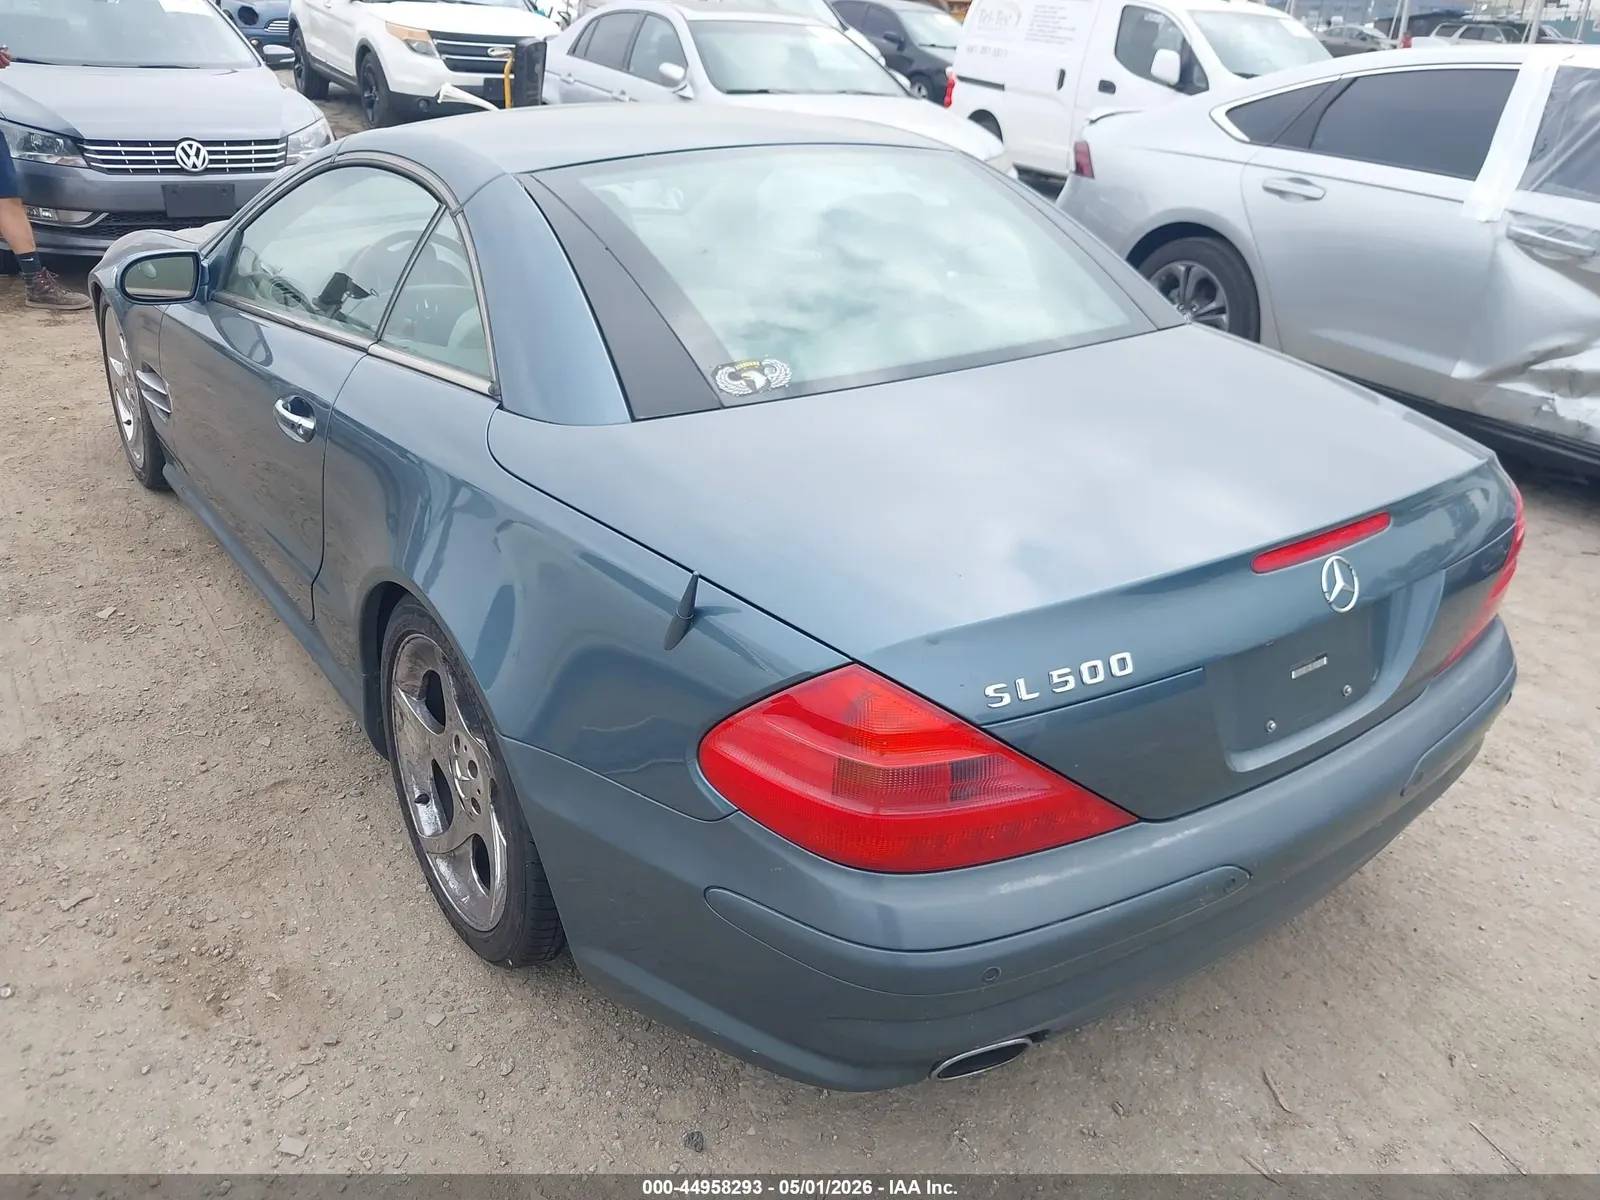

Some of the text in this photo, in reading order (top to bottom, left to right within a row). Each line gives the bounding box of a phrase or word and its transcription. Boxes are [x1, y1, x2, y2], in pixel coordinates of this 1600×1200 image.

[176, 140, 209, 171] VW
[984, 651, 1134, 709] SL 500
